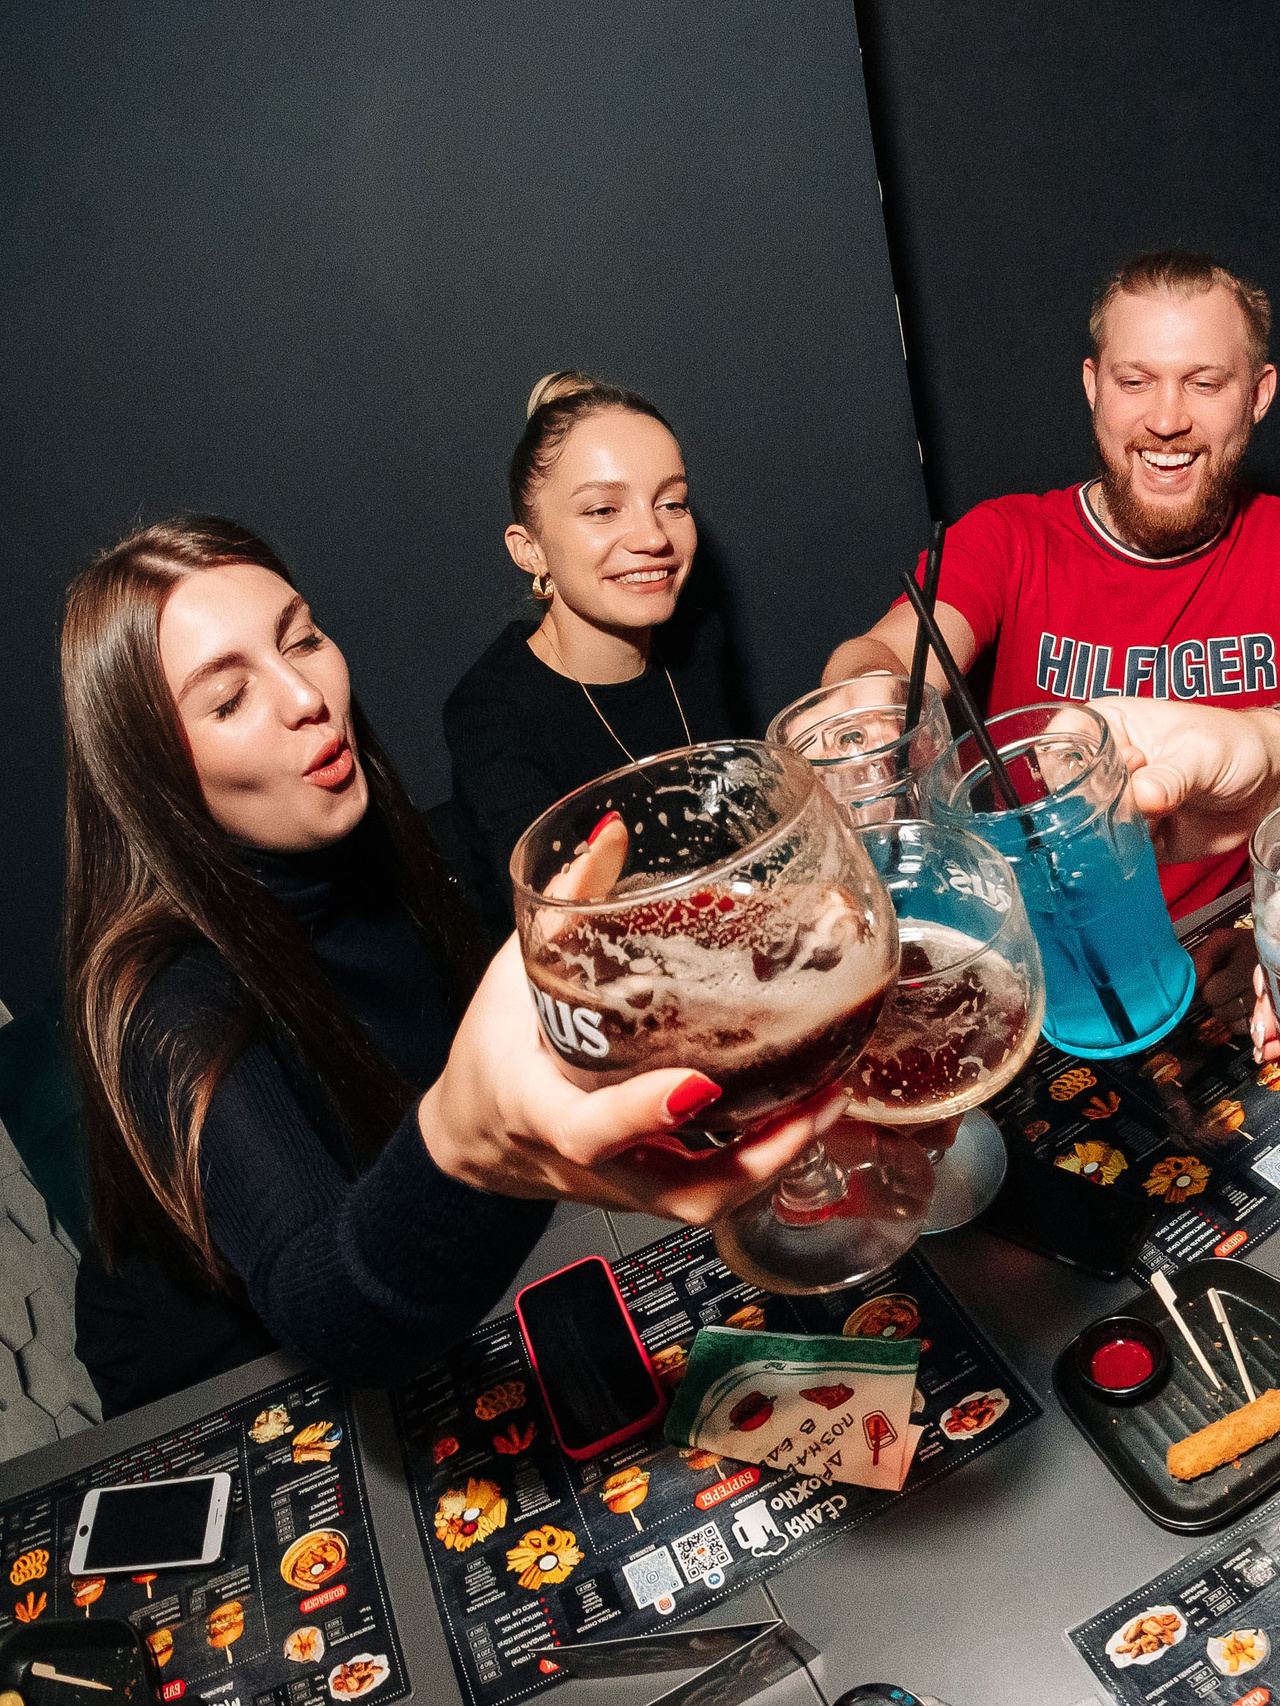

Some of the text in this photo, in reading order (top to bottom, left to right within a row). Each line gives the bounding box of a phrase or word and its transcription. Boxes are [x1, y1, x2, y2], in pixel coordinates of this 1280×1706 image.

[1036, 631, 1277, 700] HILFIGER
[1218, 1233, 1244, 1254] СНЕКИ
[700, 1471, 755, 1505] БУРГЕРЫ
[783, 1495, 847, 1540] СЁДНЯ
[303, 1586, 345, 1610] КОЛБАСКИ
